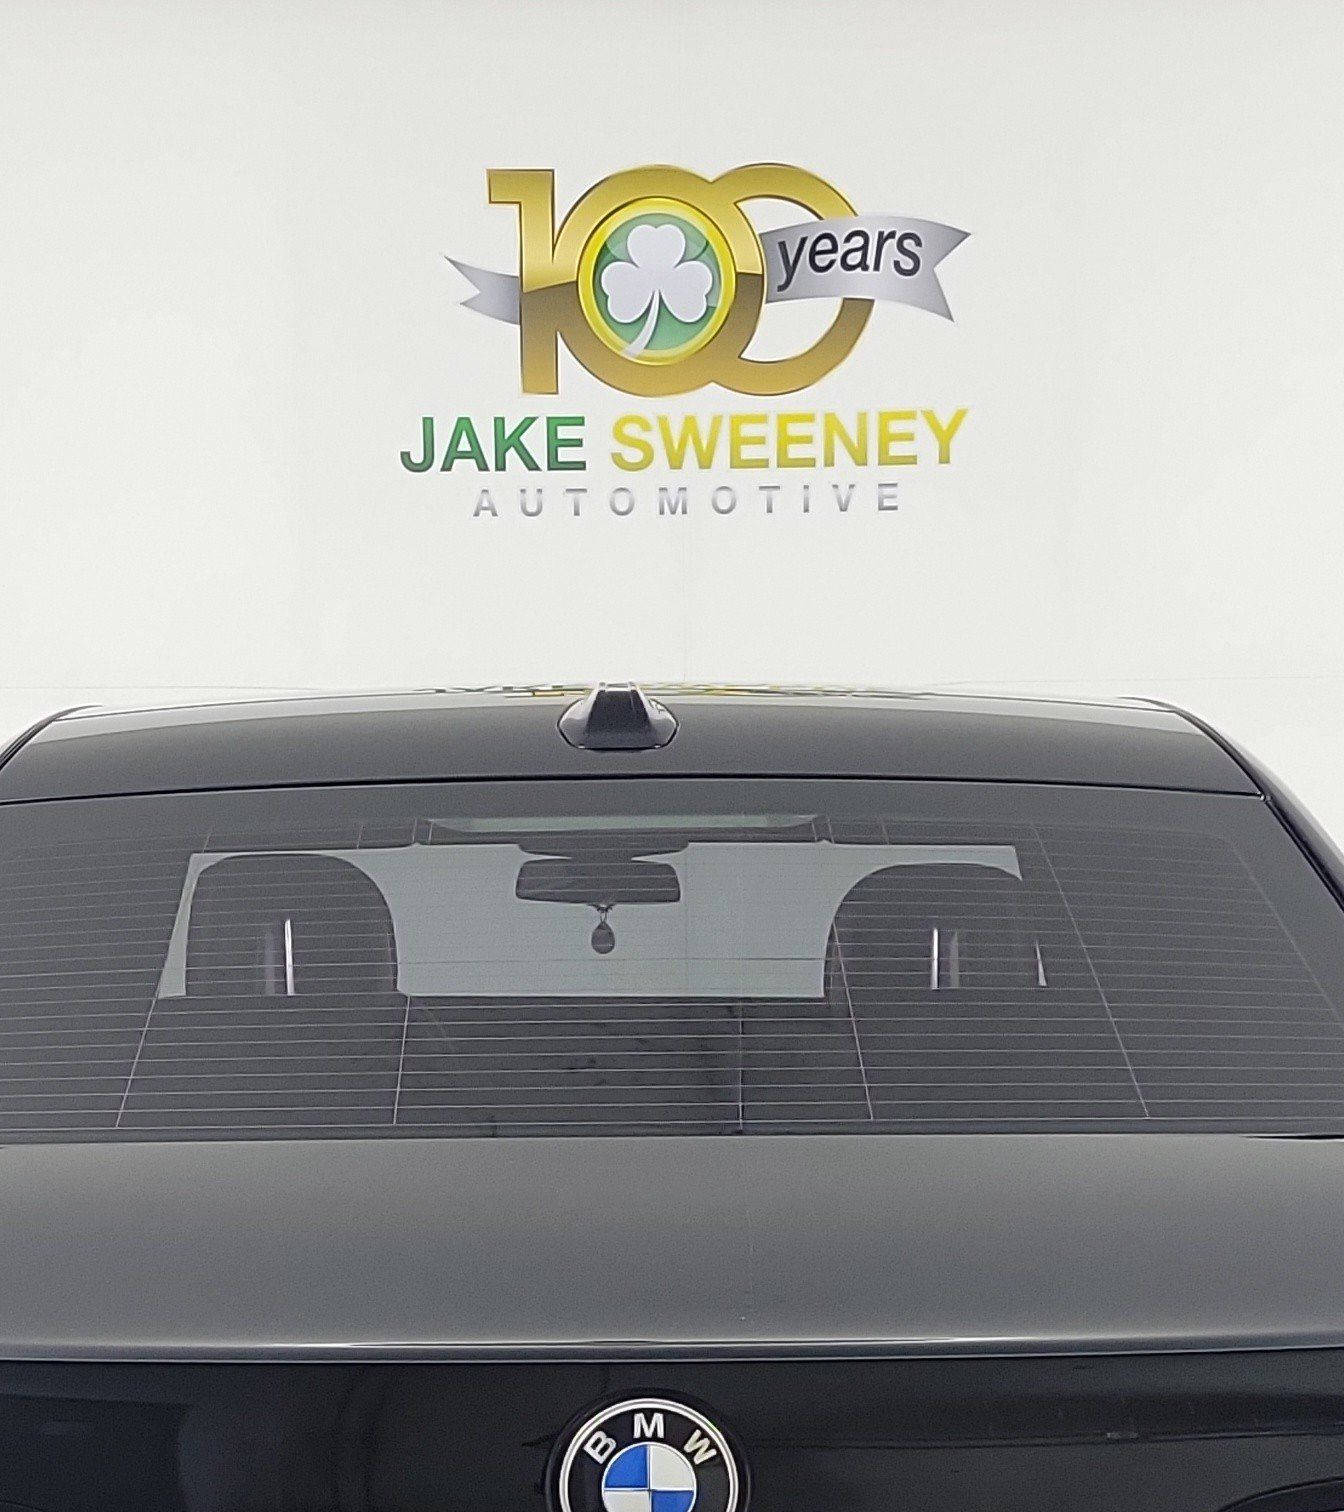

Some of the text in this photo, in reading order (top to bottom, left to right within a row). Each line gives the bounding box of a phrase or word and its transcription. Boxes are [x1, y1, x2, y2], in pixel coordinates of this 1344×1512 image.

[776, 228, 924, 292] years
[399, 408, 969, 473] JAKE SWEENEY
[472, 483, 899, 519] AUTOMOTIVE
[583, 1412, 717, 1465] BMW
